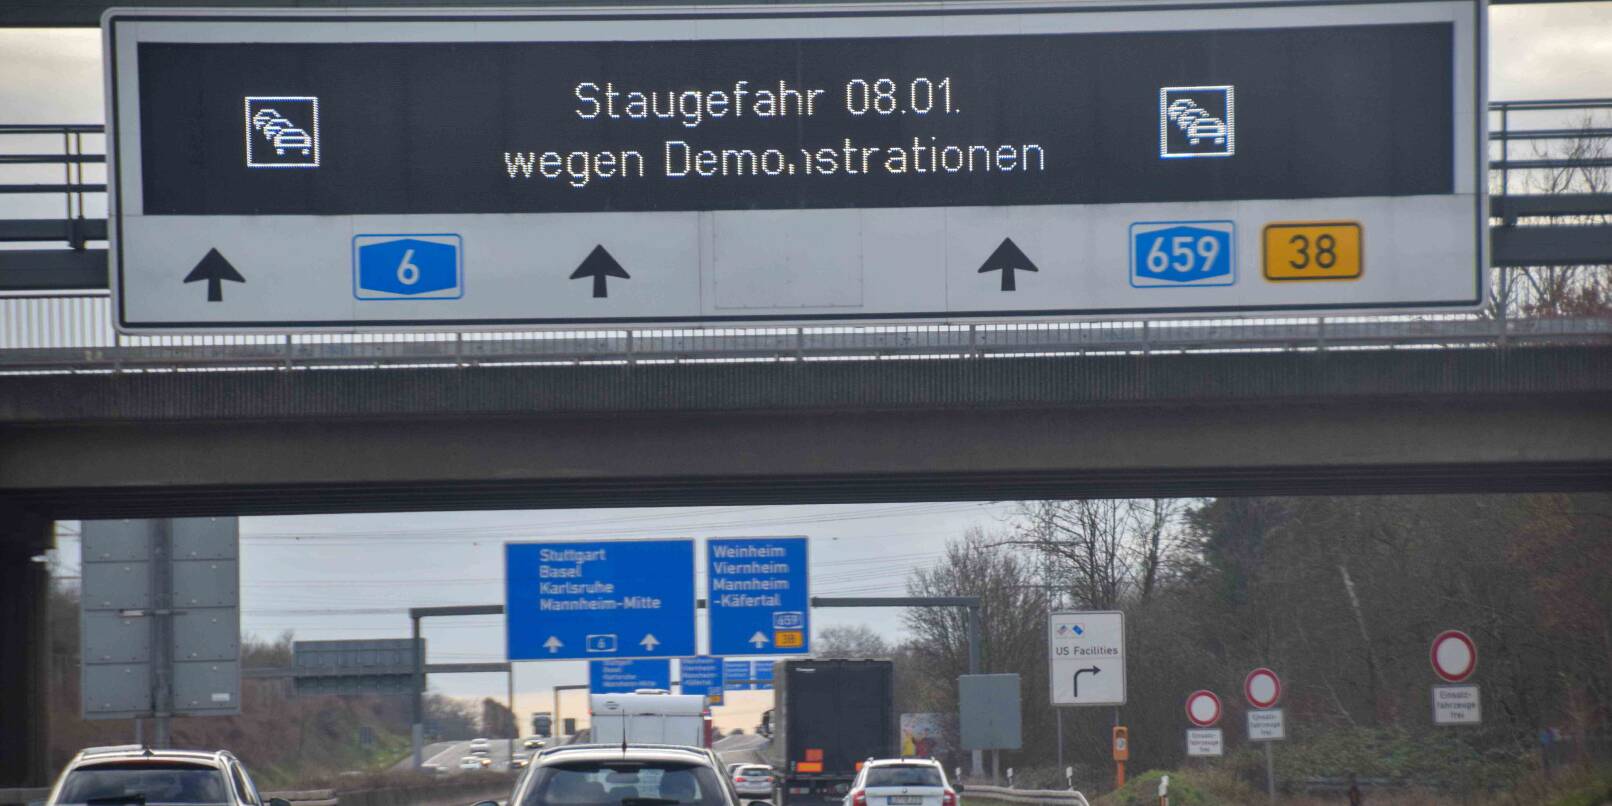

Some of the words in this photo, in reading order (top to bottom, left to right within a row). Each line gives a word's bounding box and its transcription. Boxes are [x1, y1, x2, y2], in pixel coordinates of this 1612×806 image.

[575, 80, 825, 127] Staugefahr
[845, 77, 961, 116] 08.01.
[504, 150, 644, 188] wegen
[1146, 235, 1220, 273] 659
[1288, 233, 1337, 270] 38
[397, 249, 419, 285] 6
[540, 548, 606, 564] Stuttgart
[713, 544, 786, 559] Weinheim
[540, 565, 582, 578] Basel
[713, 560, 789, 574] Viernheim
[539, 581, 615, 595] Karlsruhe
[712, 577, 789, 591] Mannheim
[540, 596, 662, 611] Mannheim-Mitte
[713, 593, 781, 608] -Käfertal
[1056, 646, 1070, 656] US
[1073, 645, 1119, 656] Facilities
